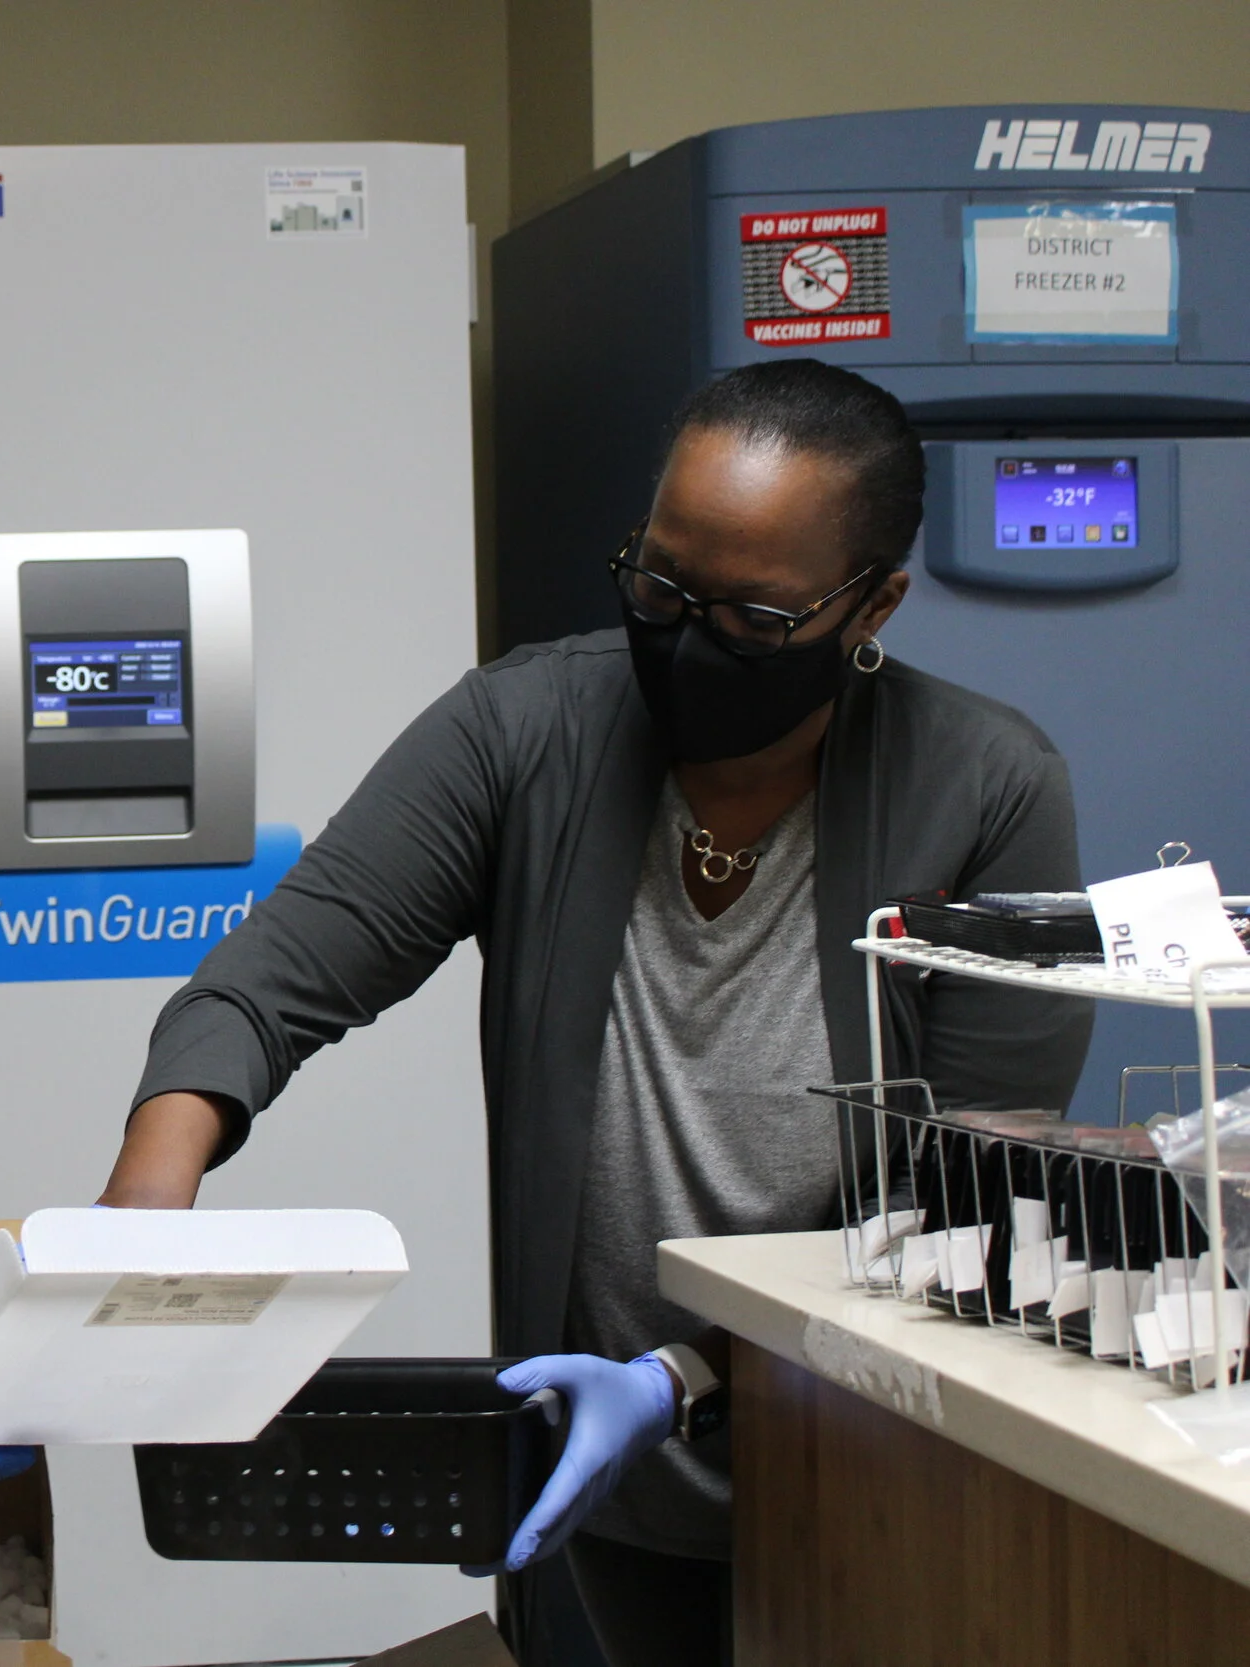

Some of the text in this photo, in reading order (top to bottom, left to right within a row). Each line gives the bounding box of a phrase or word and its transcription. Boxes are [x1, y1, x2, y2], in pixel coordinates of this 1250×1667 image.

[974, 119, 1212, 172] HELMER
[752, 213, 878, 236] DO NOT UNPLUG!
[1028, 237, 1114, 256] DISTRICT
[1014, 272, 1126, 292] FREEZER #2
[753, 318, 881, 341] VACCINES INSIDE!
[1108, 923, 1138, 968] PLE
